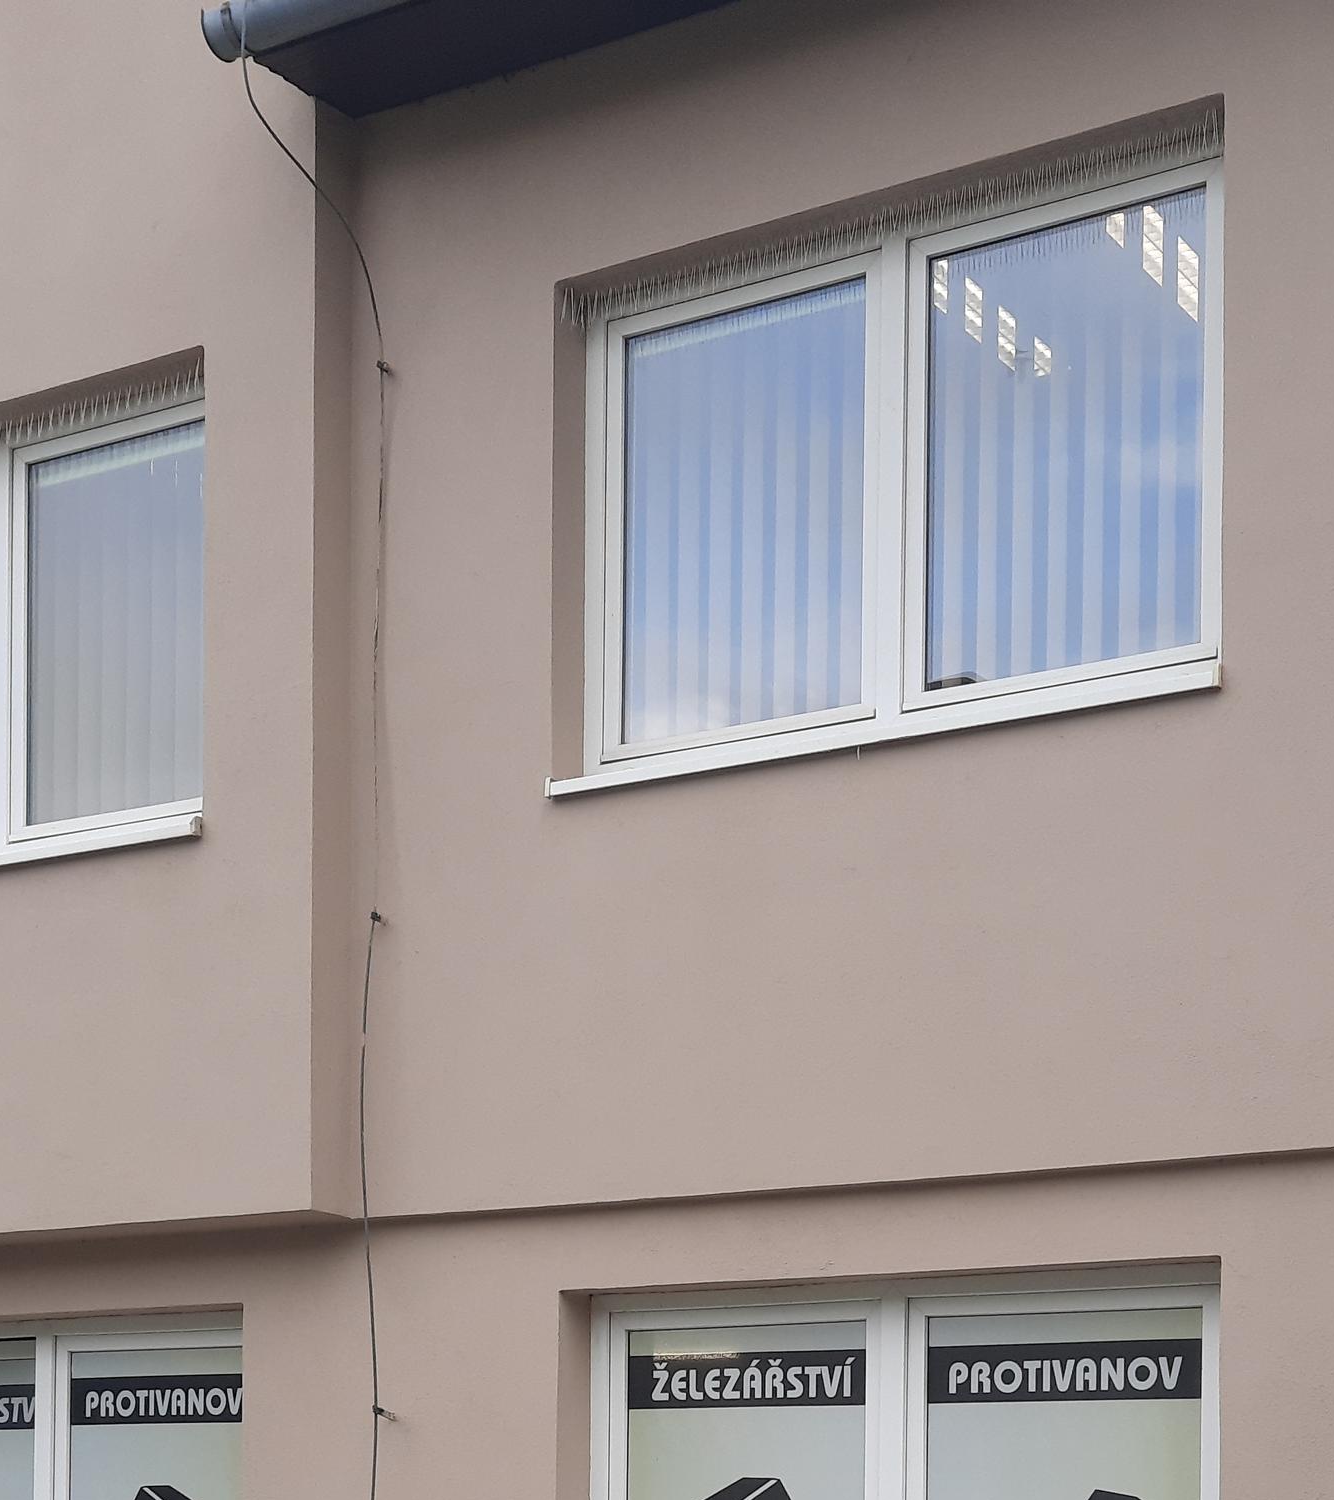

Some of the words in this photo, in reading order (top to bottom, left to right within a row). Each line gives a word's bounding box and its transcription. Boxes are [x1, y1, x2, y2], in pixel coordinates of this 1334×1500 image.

[651, 1356, 857, 1402] ŽELEZÁŘSTVÍ
[948, 1355, 1184, 1395] PROTIVANOV
[84, 1387, 243, 1418] PROTIVANOV
